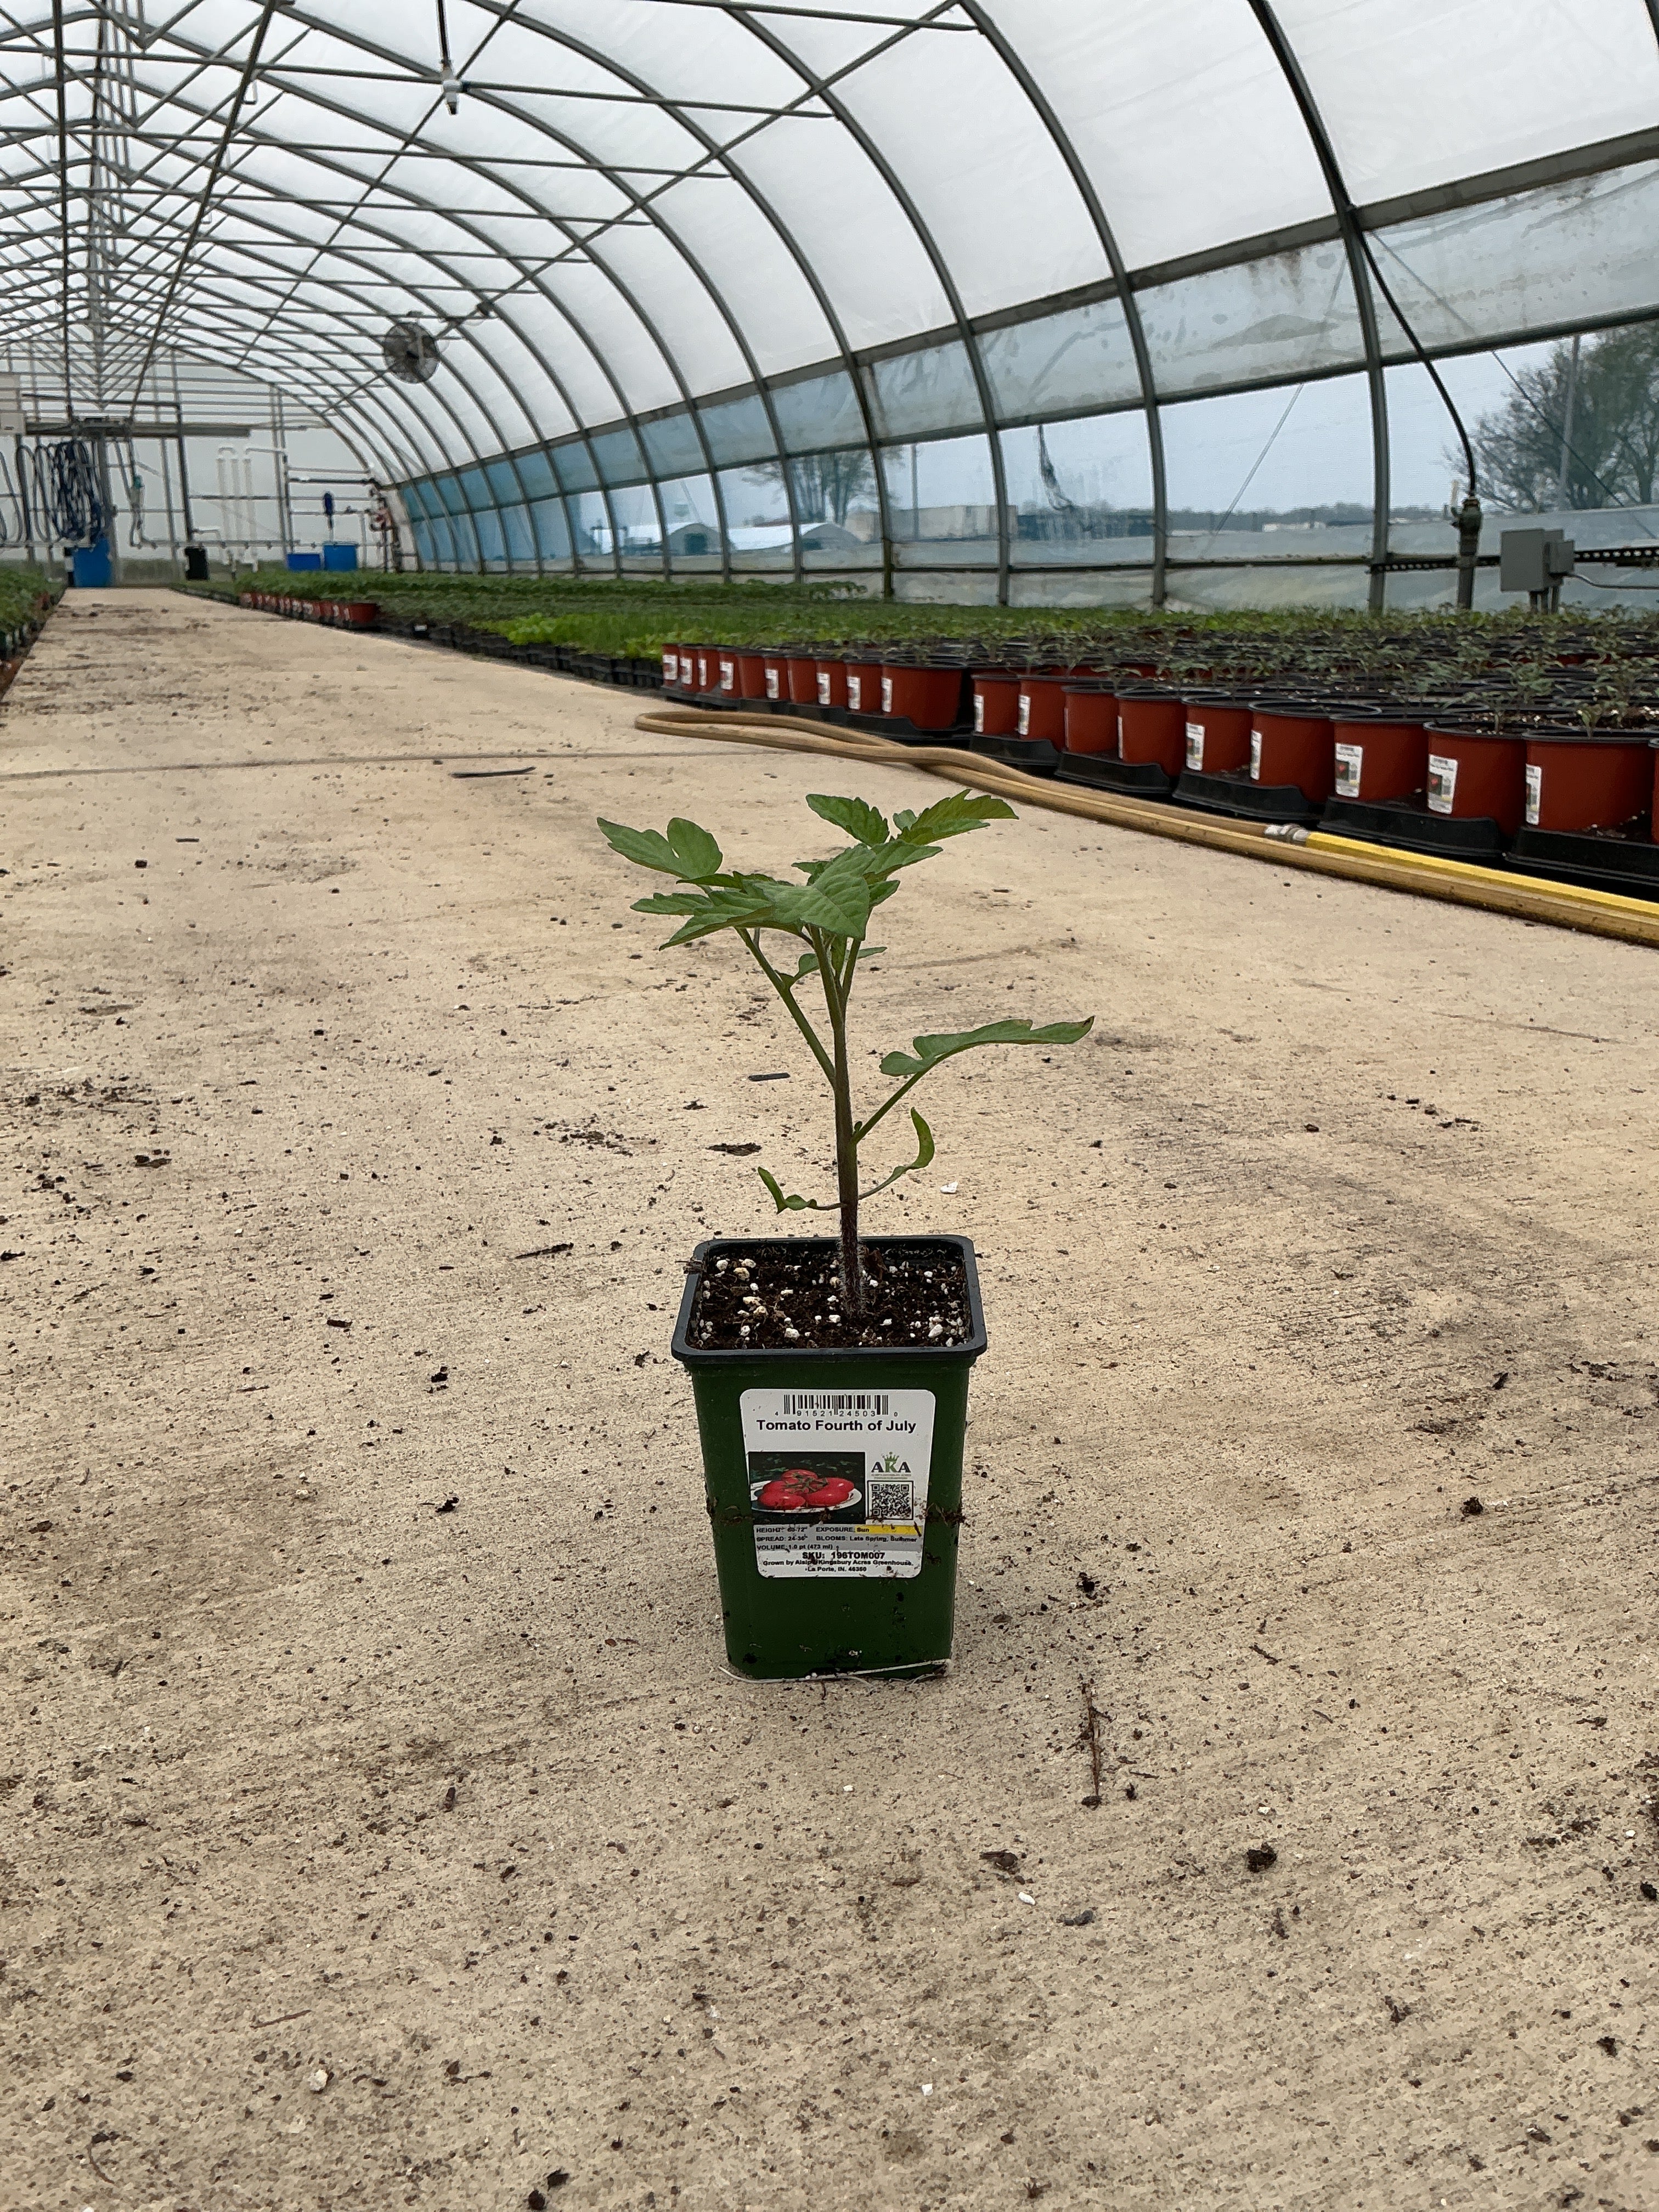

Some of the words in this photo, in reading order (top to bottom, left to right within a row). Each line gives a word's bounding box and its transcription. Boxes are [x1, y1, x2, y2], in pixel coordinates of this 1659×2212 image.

[756, 1419, 811, 1430] Tomato
[815, 1420, 863, 1431] Fourth
[867, 1420, 883, 1431] of
[885, 1420, 917, 1434] July
[871, 1459, 911, 1473] AKA
